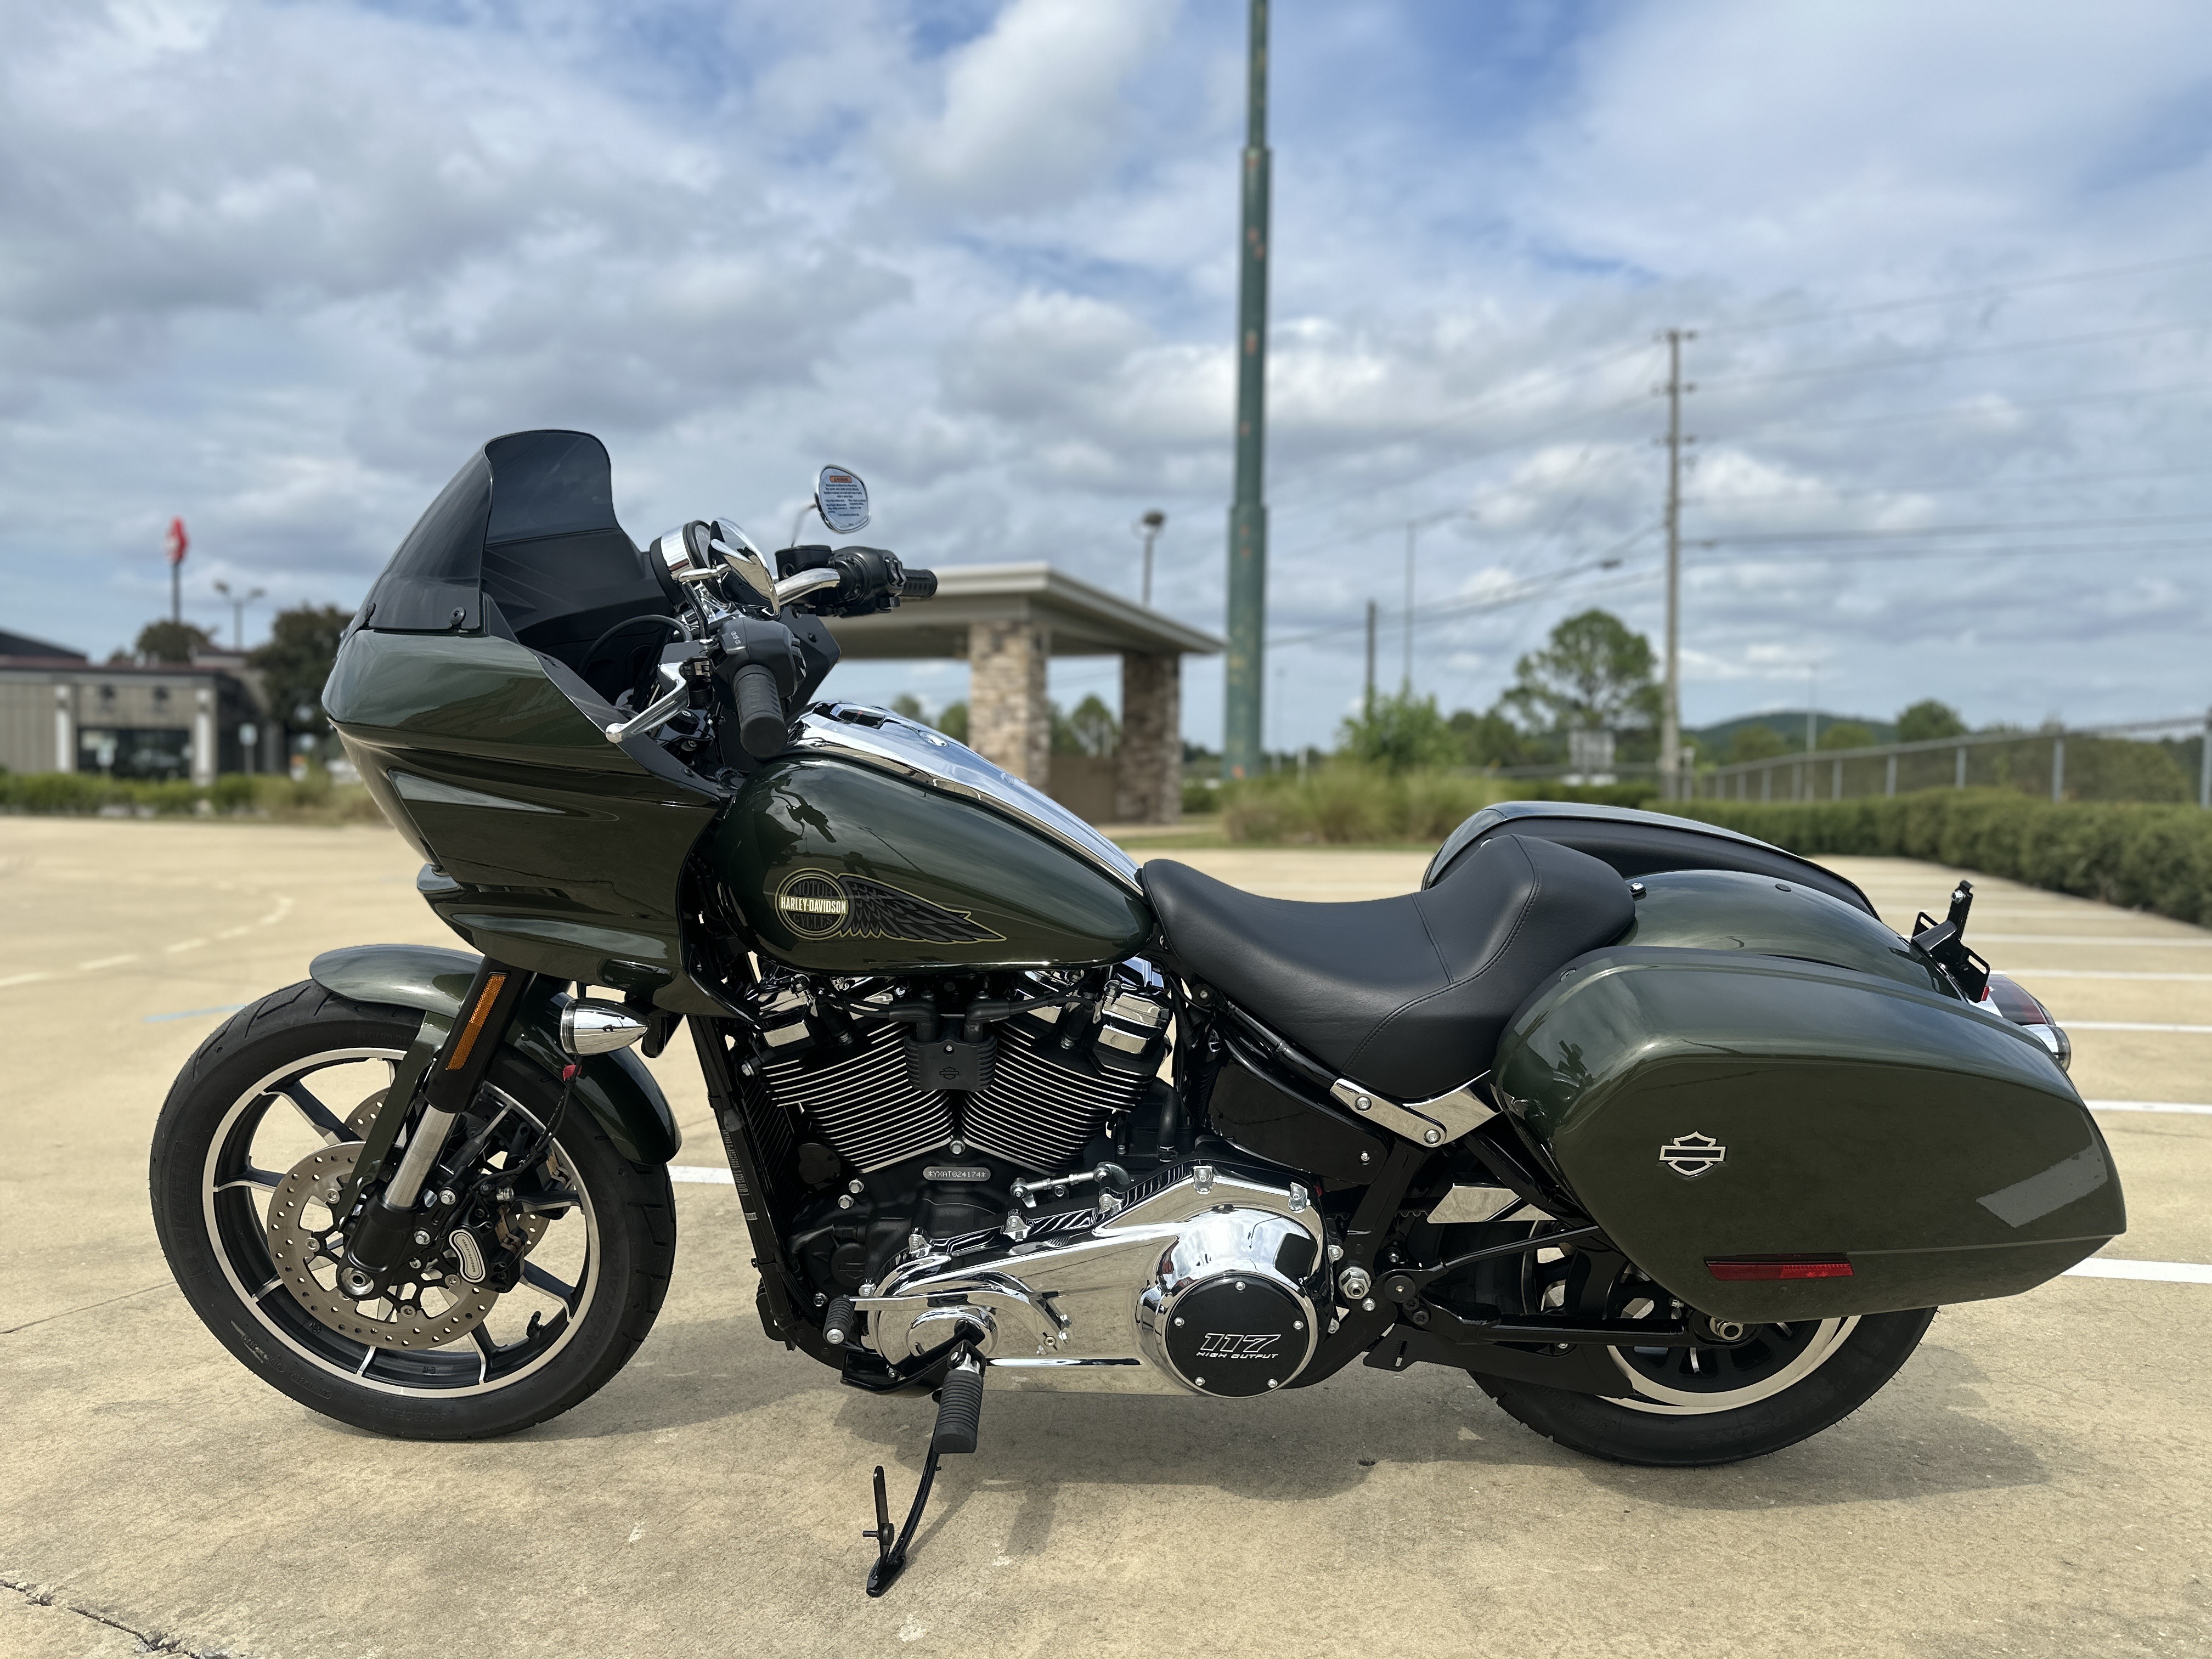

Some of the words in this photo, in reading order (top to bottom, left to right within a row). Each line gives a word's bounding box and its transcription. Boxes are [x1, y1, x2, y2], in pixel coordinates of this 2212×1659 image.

[794, 881, 833, 898] MOTOR
[781, 896, 846, 913] HARLEY-DAVIDSON
[793, 913, 833, 929] CYCLES
[1200, 1333, 1282, 1352] 117
